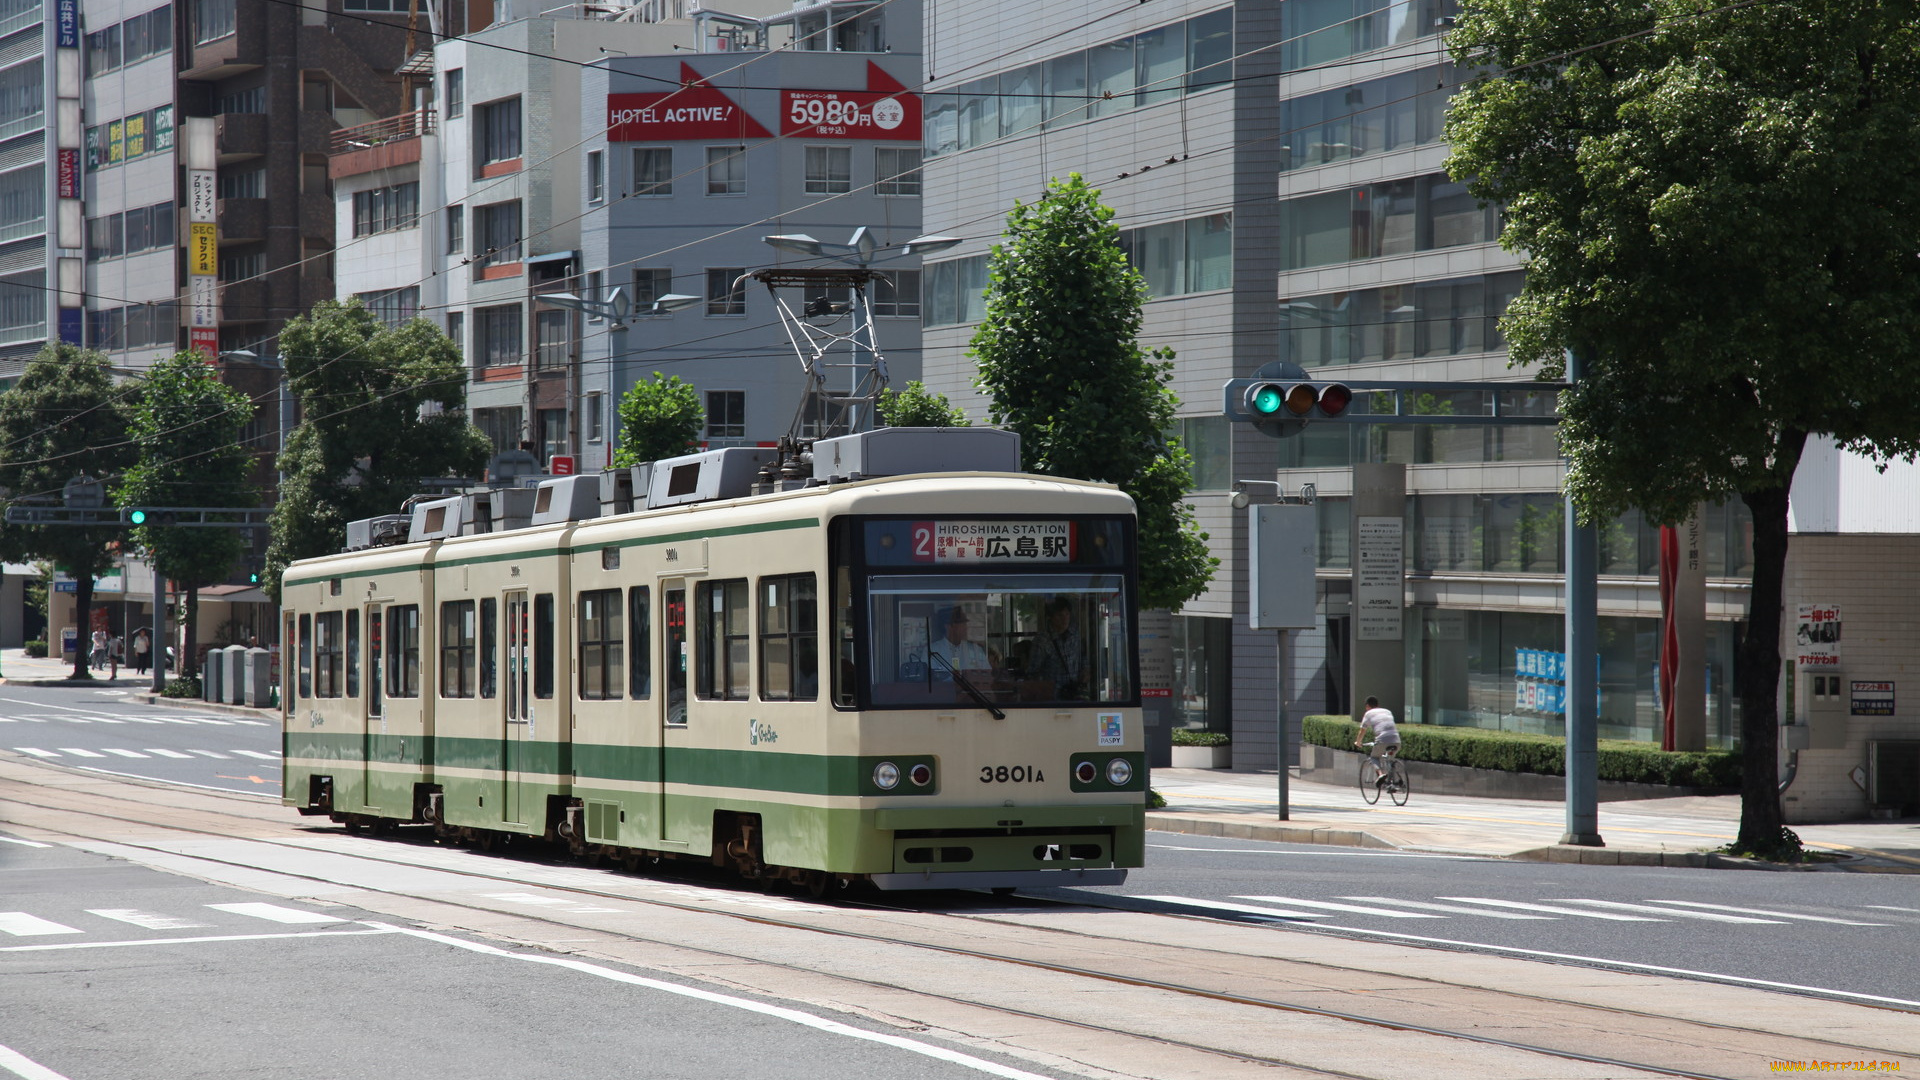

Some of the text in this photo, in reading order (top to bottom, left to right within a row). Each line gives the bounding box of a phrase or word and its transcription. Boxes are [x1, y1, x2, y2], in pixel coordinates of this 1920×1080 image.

[611, 106, 733, 124] HOTEL ACTIVE!
[192, 226, 214, 235] SEC
[939, 525, 1066, 535] HIROSHIMA STATION
[915, 528, 930, 556] 2
[937, 536, 985, 547] 原爆ドーム前
[985, 535, 1068, 558] 広島駅
